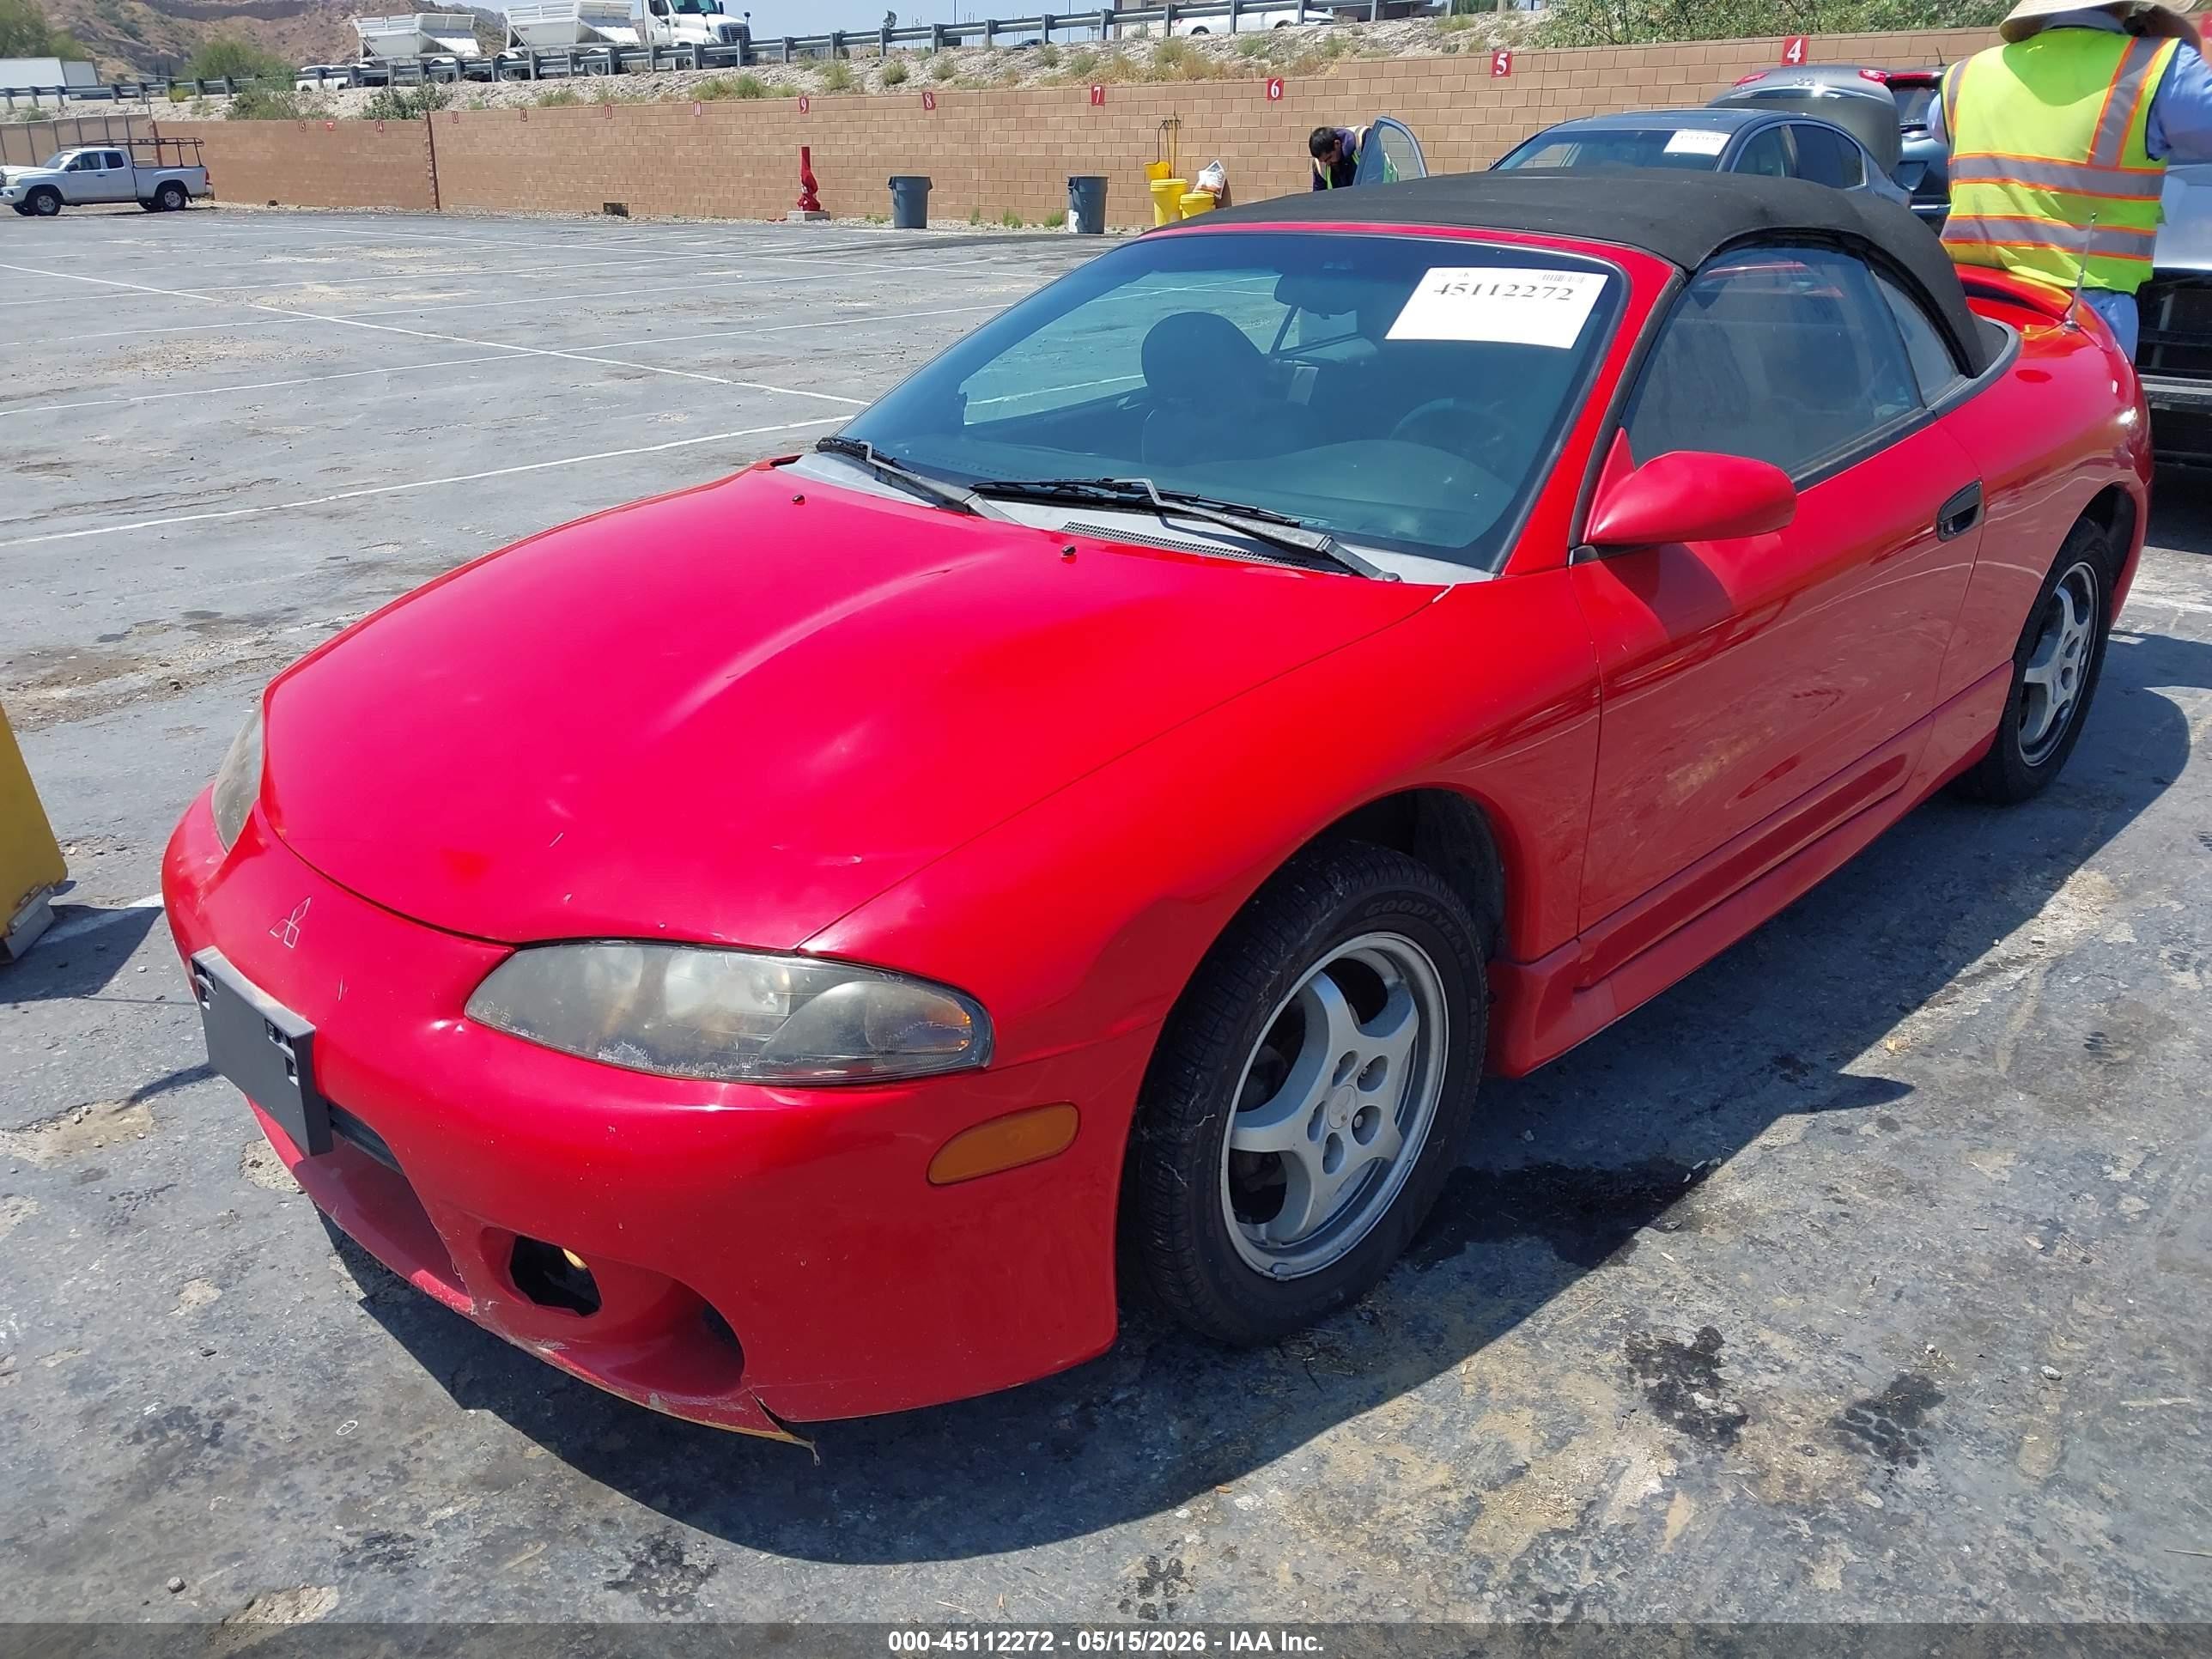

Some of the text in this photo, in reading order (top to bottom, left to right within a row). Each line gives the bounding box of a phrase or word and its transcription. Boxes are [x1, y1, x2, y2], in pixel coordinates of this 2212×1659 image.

[1786, 38, 1802, 64] 4
[1495, 52, 1508, 75] 5
[1093, 86, 1101, 104] 7
[1270, 78, 1280, 99] 6
[694, 101, 702, 117] 10
[799, 97, 807, 113] 9
[924, 92, 933, 109] 8
[605, 106, 612, 118] 11
[375, 120, 383, 131] 14
[1433, 283, 1574, 301] 45112272
